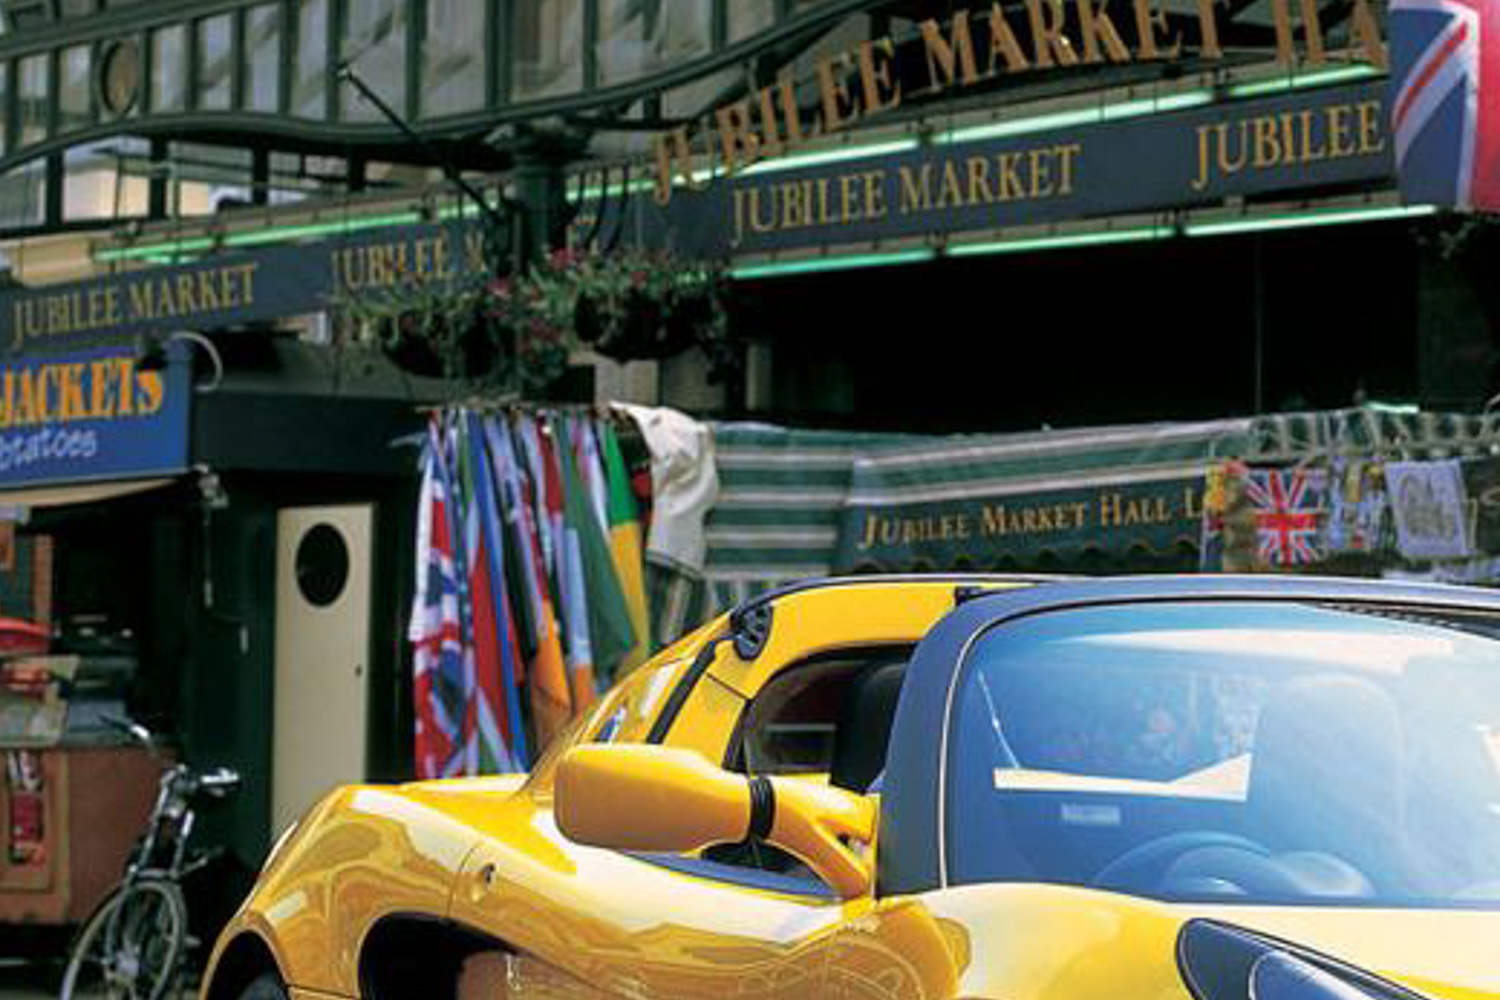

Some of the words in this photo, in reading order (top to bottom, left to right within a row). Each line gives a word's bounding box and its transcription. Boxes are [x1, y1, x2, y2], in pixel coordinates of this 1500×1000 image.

[652, 34, 903, 204] JUBILEE
[1192, 100, 1387, 191] JUBILEE
[730, 169, 888, 249] JUBILEE
[899, 143, 1081, 213] MARKET
[13, 285, 119, 351] JUBILEE
[129, 266, 256, 320] MARKET
[857, 512, 971, 550] JUBILEE
[981, 502, 1086, 538] MARKET
[1100, 492, 1172, 526] HALL
